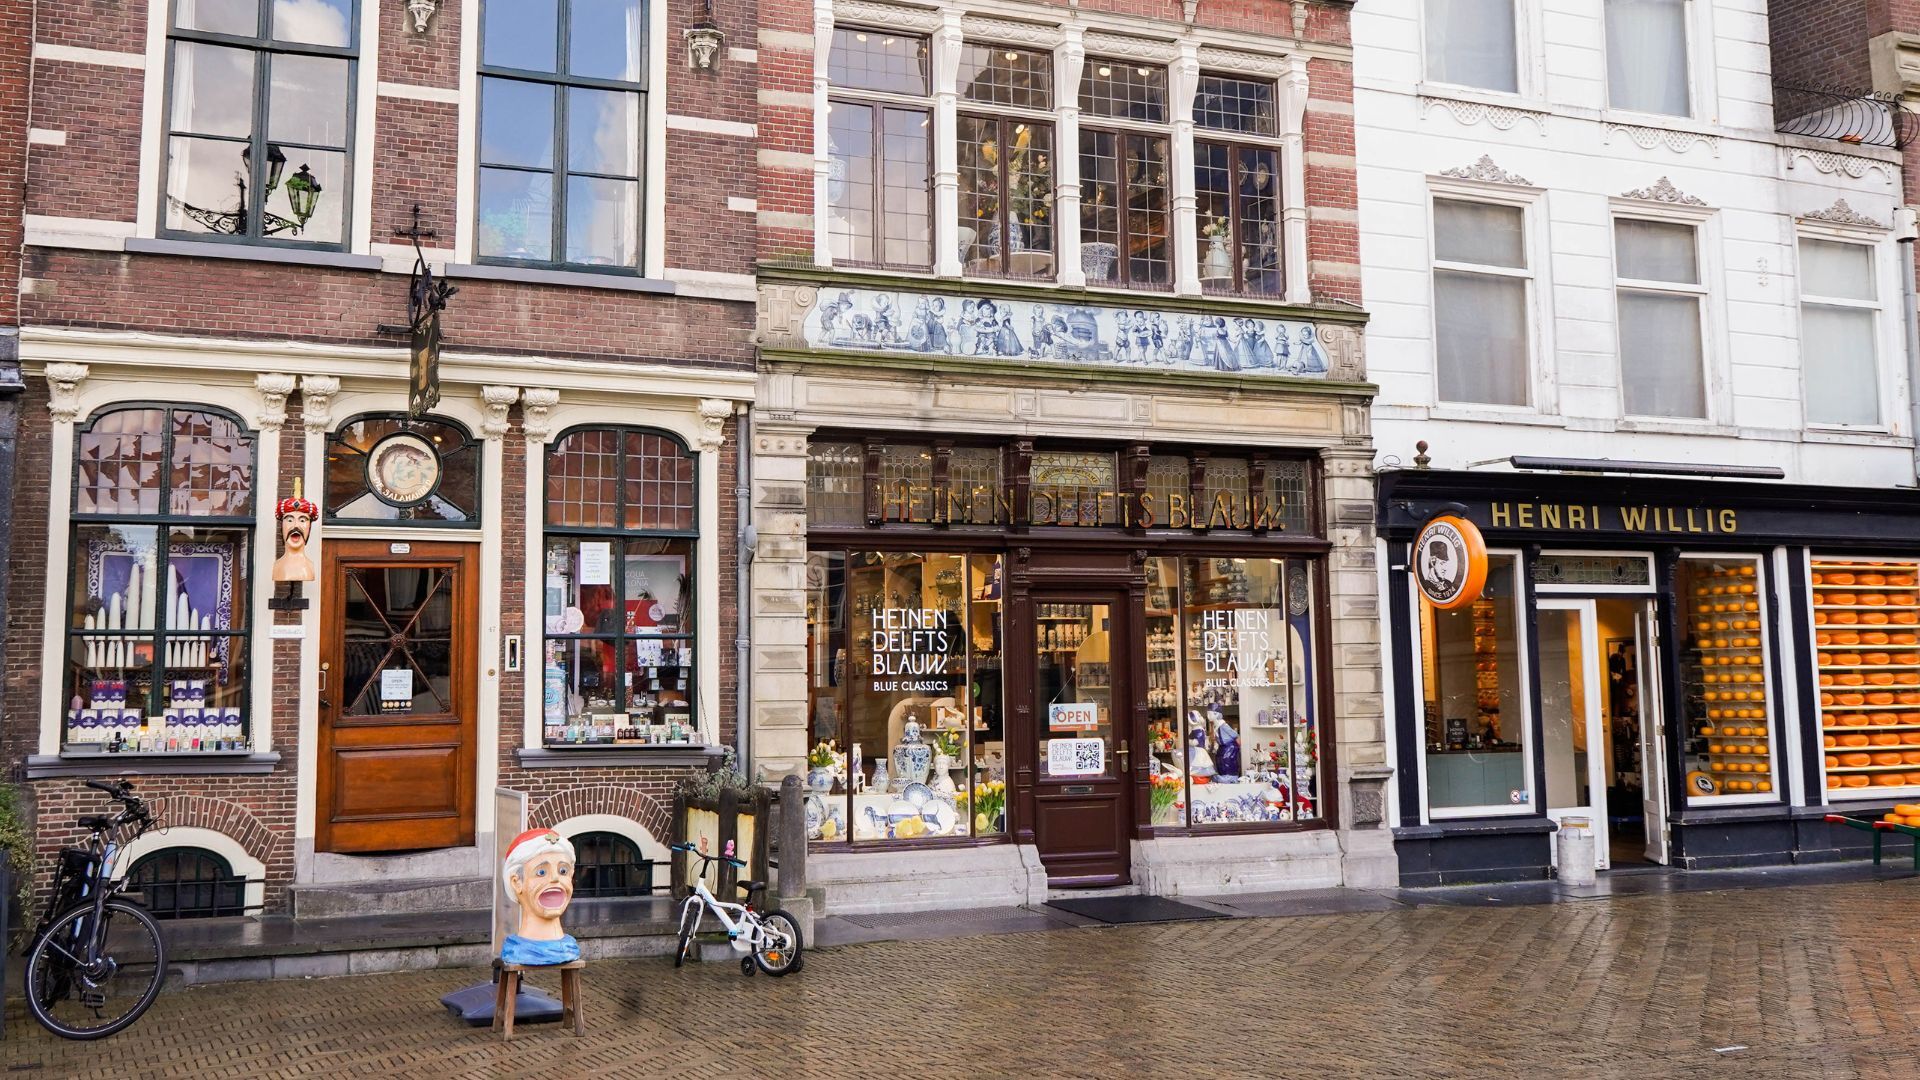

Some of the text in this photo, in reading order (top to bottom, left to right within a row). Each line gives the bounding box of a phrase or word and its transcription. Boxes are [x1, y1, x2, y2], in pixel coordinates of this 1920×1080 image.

[882, 485, 1014, 524] HEINEN
[1030, 489, 1155, 528] DELFTS
[1491, 502, 1737, 533] HENRI WILLIG
[1418, 526, 1460, 552] HENRI WILLIG
[1427, 586, 1456, 598] SINCE 1974
[873, 608, 947, 629] HEINEN
[1203, 610, 1268, 630] HEINEN
[873, 631, 948, 652] DELFTS
[1204, 631, 1269, 651] DELFTS
[873, 653, 947, 675] BLAUW.
[873, 681, 948, 691] BLUE CLASSICS
[1206, 678, 1270, 687] BLUE CLASSICS
[1057, 710, 1091, 722] OPEN
